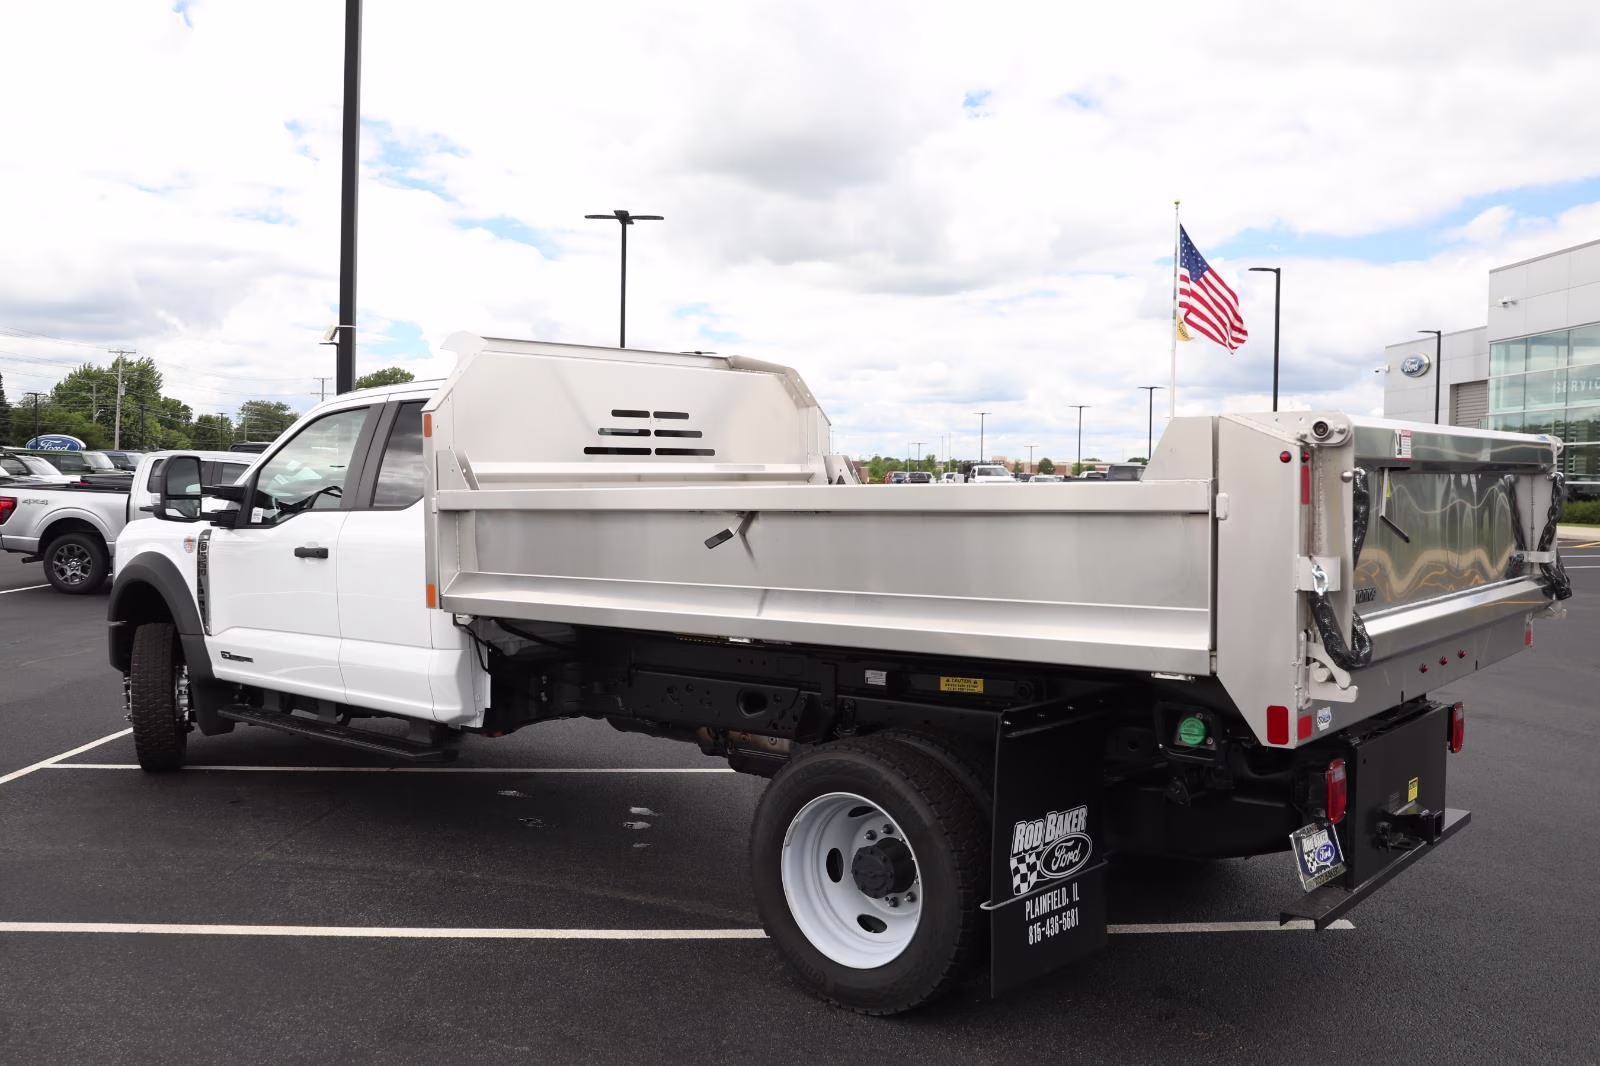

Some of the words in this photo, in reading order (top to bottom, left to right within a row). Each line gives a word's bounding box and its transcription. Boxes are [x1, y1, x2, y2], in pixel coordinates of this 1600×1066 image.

[1403, 358, 1420, 372] Ford
[1011, 820, 1045, 856] ROD
[1044, 806, 1087, 844] BAKER
[1051, 839, 1082, 872] Ford
[1319, 845, 1332, 861] Ford
[1072, 882, 1080, 902] IL
[1028, 906, 1080, 945] 815-436-5681
